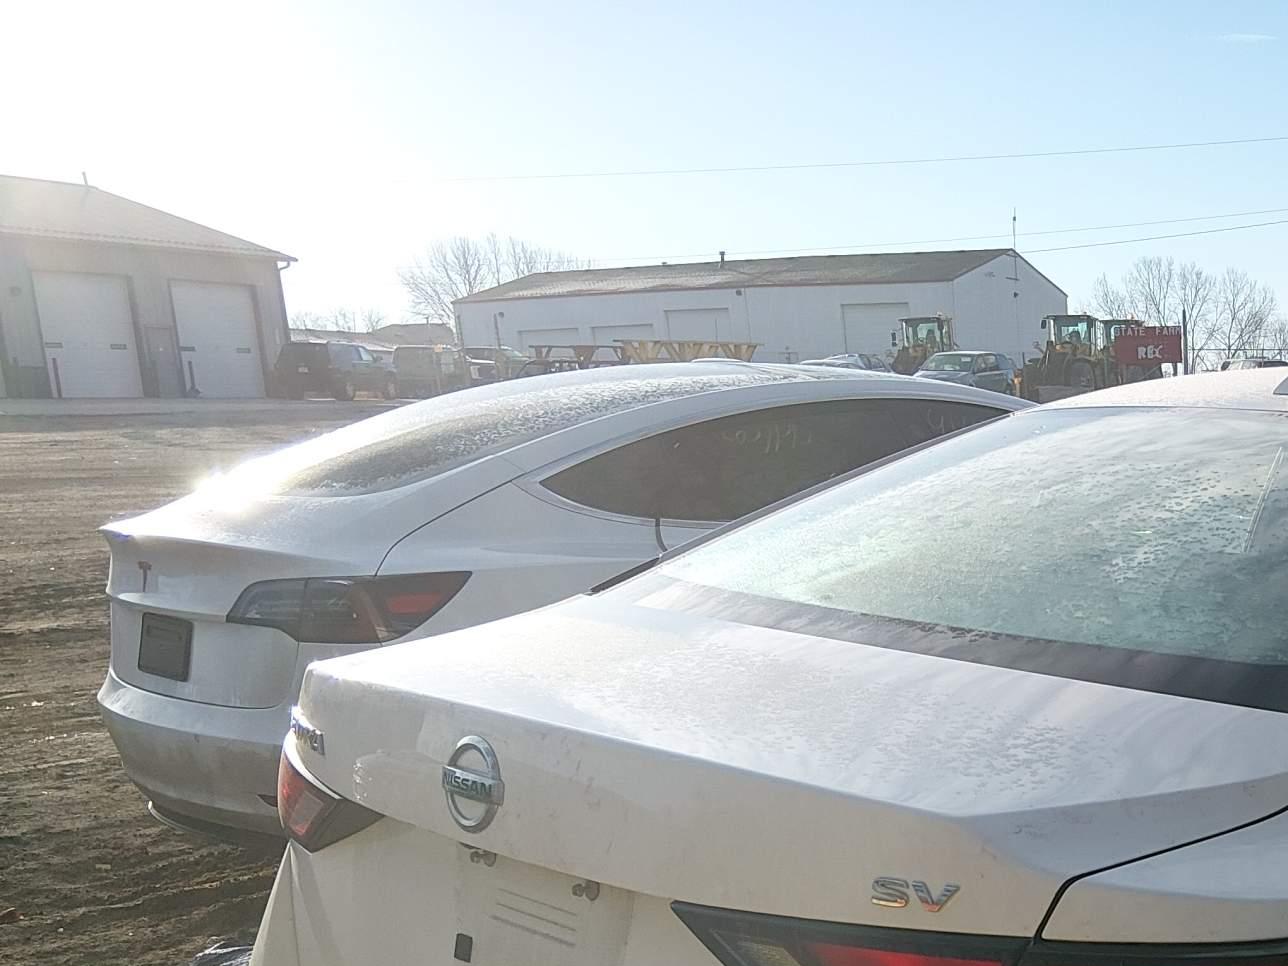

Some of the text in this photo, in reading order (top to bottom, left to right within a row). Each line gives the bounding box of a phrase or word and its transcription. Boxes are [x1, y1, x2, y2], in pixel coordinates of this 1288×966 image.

[1115, 326, 1145, 337] STATE
[442, 766, 494, 794] NISSAN
[871, 876, 961, 913] SV
